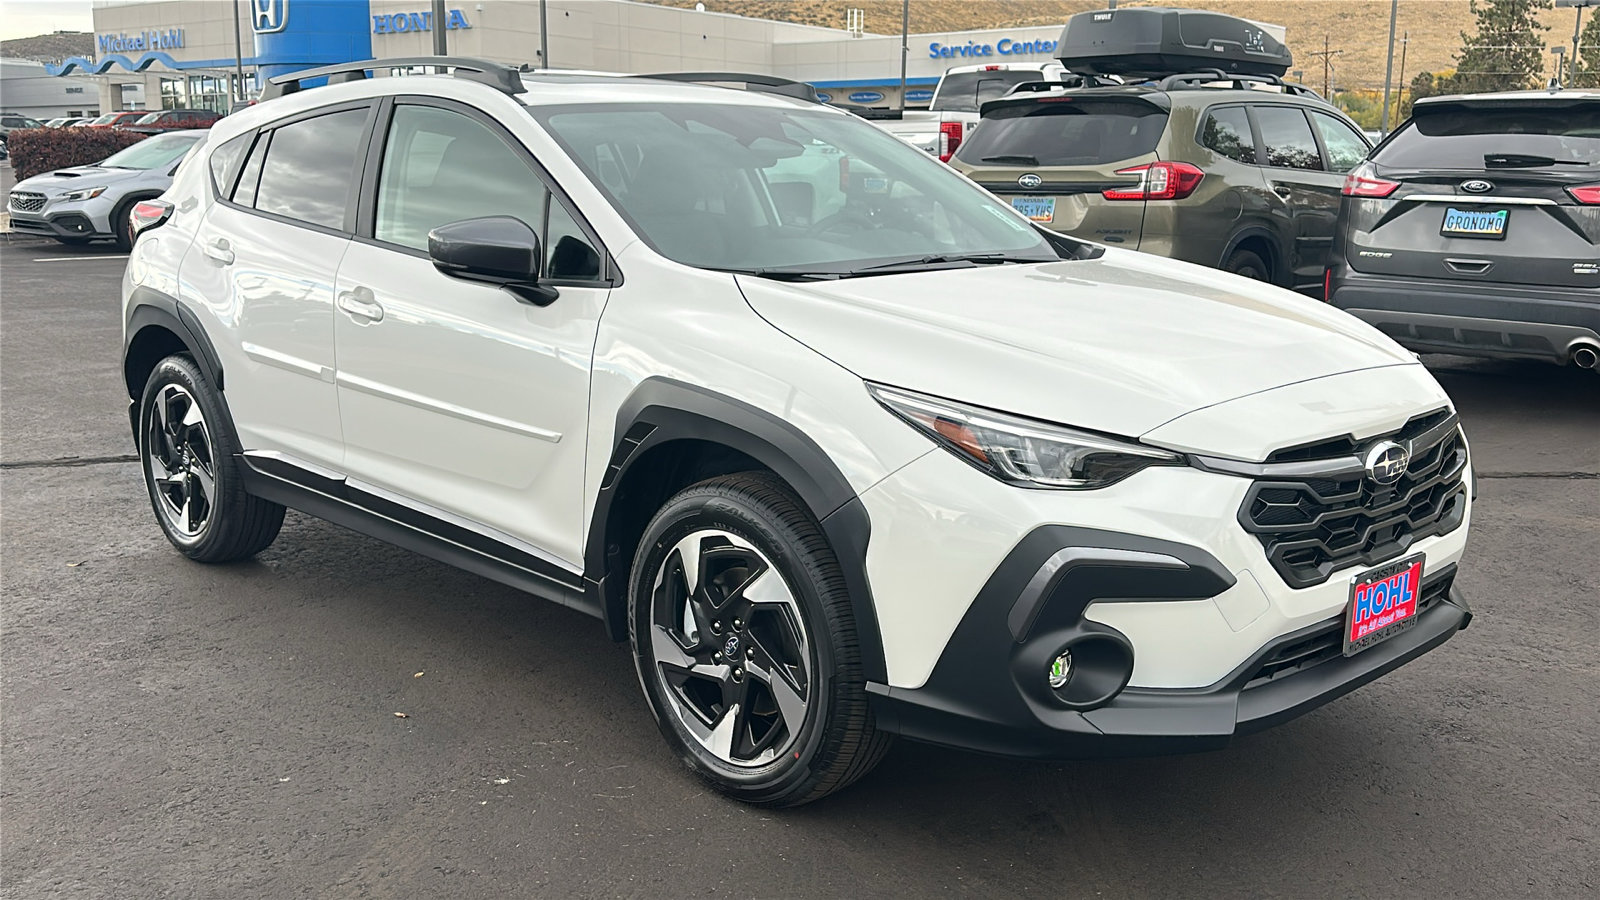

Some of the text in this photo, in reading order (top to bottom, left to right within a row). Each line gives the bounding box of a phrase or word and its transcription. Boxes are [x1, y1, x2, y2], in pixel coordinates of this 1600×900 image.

[373, 10, 470, 34] HONA
[98, 29, 184, 53] Michael Hohl
[929, 40, 992, 59] Service
[1447, 215, 1503, 231] GRONOMO
[1359, 251, 1393, 259] EDGE
[1355, 571, 1412, 625] HOHL
